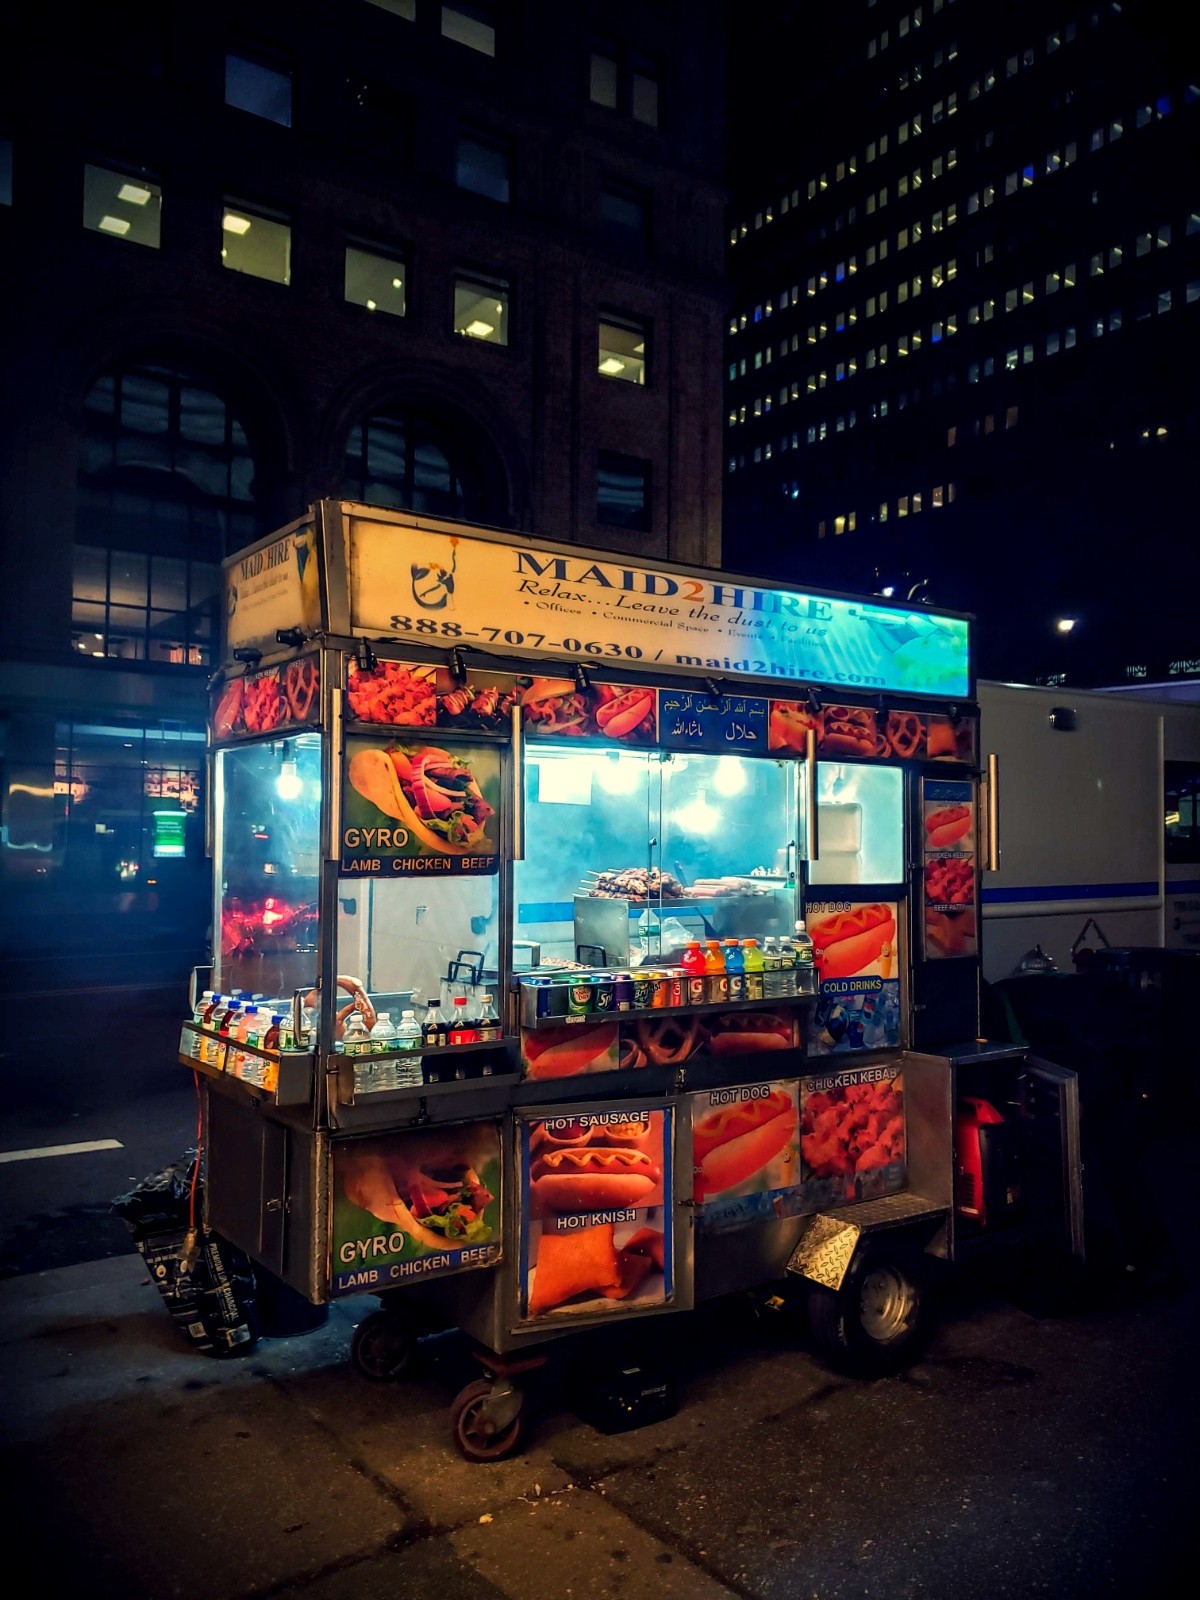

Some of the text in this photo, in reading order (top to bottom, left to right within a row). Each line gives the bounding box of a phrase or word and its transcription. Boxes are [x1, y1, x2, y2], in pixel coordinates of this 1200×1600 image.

[512, 550, 833, 622] MAID2HIRE
[536, 601, 582, 614] Offices
[603, 611, 673, 628] Commercial
[677, 622, 709, 634] Space
[688, 605, 720, 622] the
[727, 611, 772, 629] dust
[781, 621, 798, 632] to
[806, 627, 828, 637] us
[389, 615, 643, 659] 888-707-0630
[675, 654, 887, 686] maid2hire.com
[725, 722, 757, 740] حلال
[343, 827, 409, 848] GYRO
[341, 857, 494, 872] LAMB CHICKEN BEEF
[805, 901, 852, 914] HOT DOG
[933, 904, 949, 912] BEEF
[823, 979, 882, 993] COLD DRINKS
[807, 1067, 898, 1092] CHICKEN KEBAB
[709, 1086, 770, 1106] HOT DOG
[544, 1111, 650, 1131] HOT SAUSAGE
[557, 1209, 636, 1229] HOT KNISH
[339, 1231, 405, 1263] GYRO
[338, 1245, 495, 1290] LAMB CHICKEN BEEF
